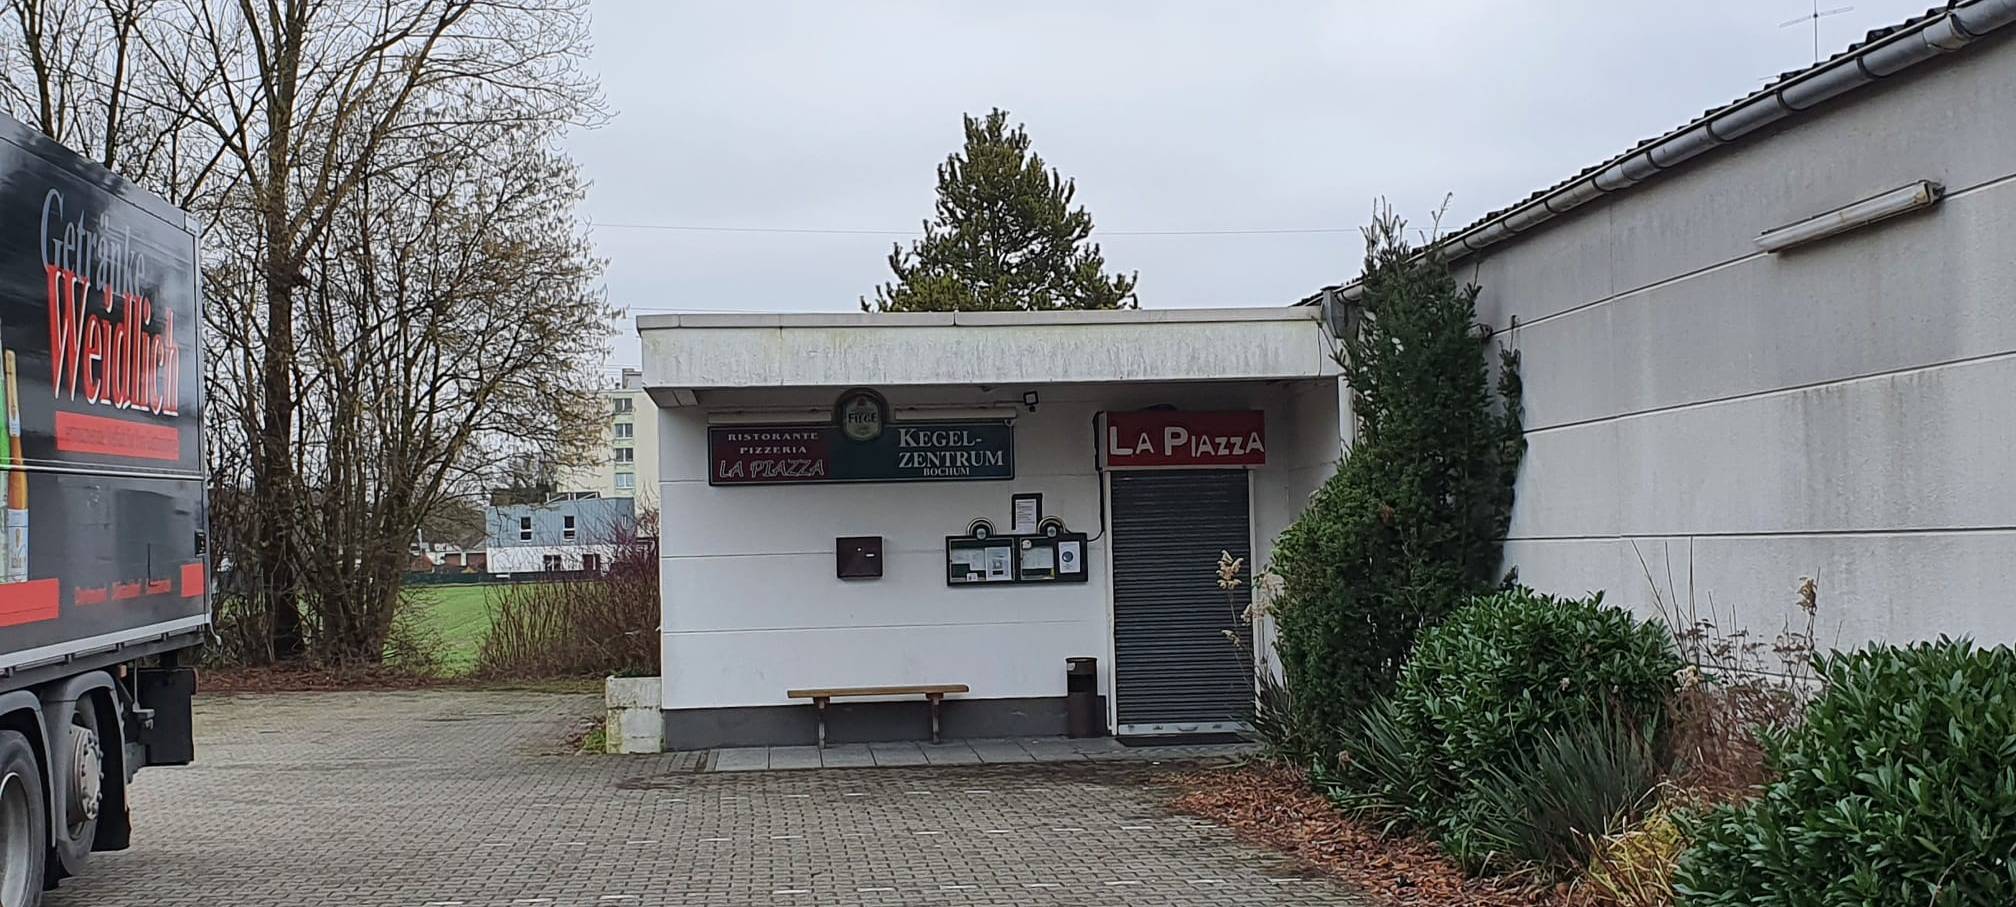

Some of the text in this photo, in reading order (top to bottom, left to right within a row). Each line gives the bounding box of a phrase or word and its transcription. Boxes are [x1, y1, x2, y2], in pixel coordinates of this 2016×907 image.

[40, 188, 145, 299] Getränke
[48, 265, 179, 416] Weidlich
[728, 432, 819, 441] RISTORANTE
[898, 428, 983, 448] KEGEL-
[1109, 426, 1265, 458] LA PIAZZA
[740, 446, 807, 455] PIZZERIA
[899, 450, 1004, 468] ZENTRUM
[719, 459, 825, 478] LA PIAZZA
[923, 467, 970, 477] BOCHUM
